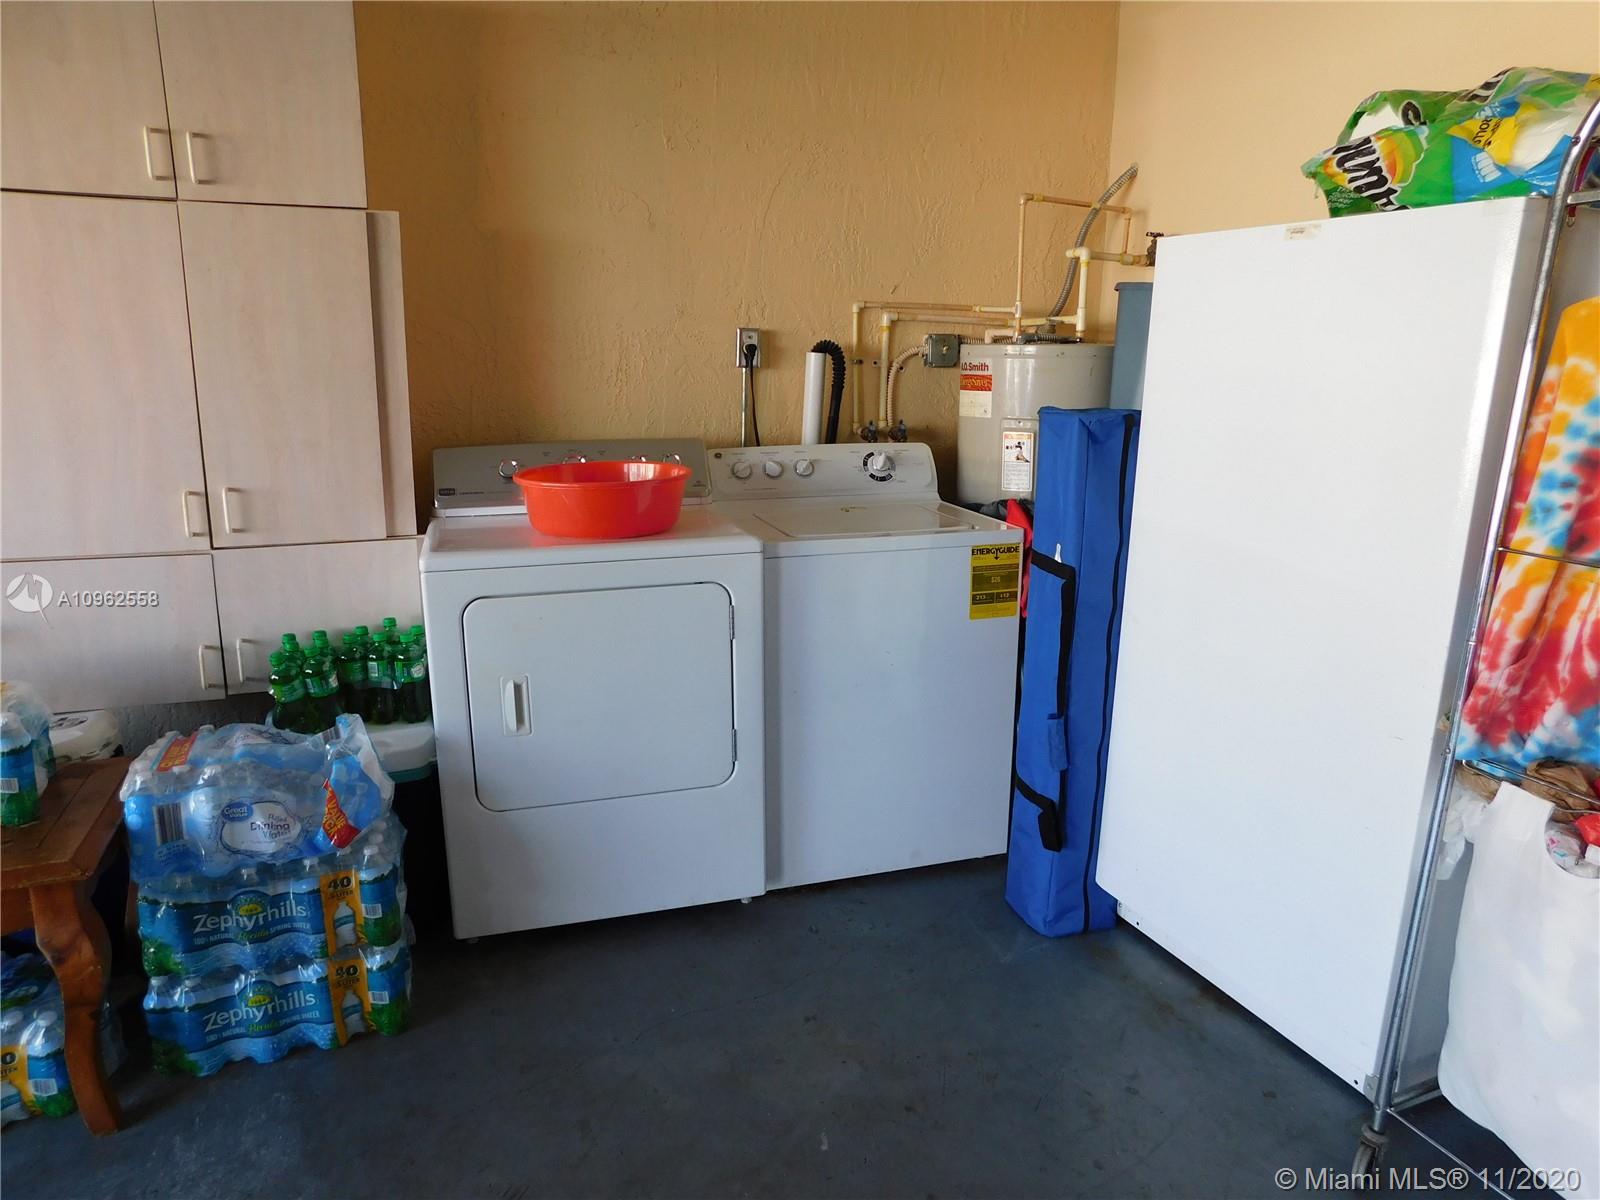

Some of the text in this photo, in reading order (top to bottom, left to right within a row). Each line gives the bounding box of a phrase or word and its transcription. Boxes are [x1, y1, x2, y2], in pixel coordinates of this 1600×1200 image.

[328, 876, 352, 890] 40
[192, 901, 308, 934] Zephyrhills
[203, 991, 316, 1031] Zephyrhills
[0, 1052, 17, 1065] 0
